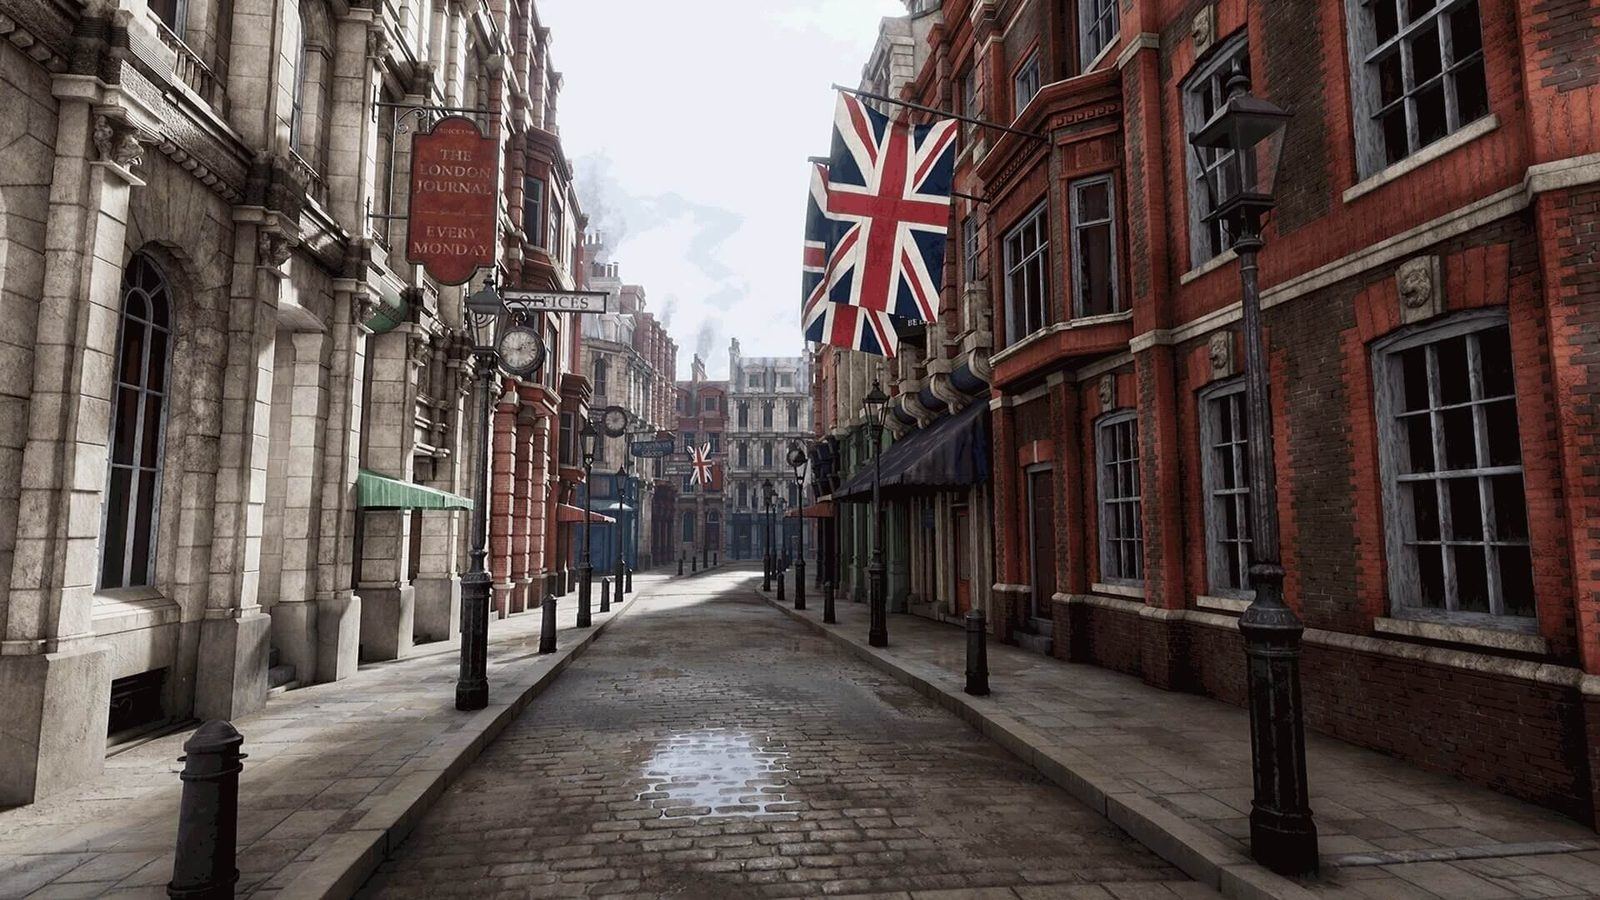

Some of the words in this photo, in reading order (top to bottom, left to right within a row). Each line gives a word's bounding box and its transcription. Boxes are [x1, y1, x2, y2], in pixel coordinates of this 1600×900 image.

[440, 149, 472, 161] THE
[419, 163, 492, 178] LONDON
[416, 180, 492, 195] JOURNAL
[426, 225, 479, 239] EVERY
[413, 241, 488, 257] MONDAY
[520, 294, 589, 310] OFFICES
